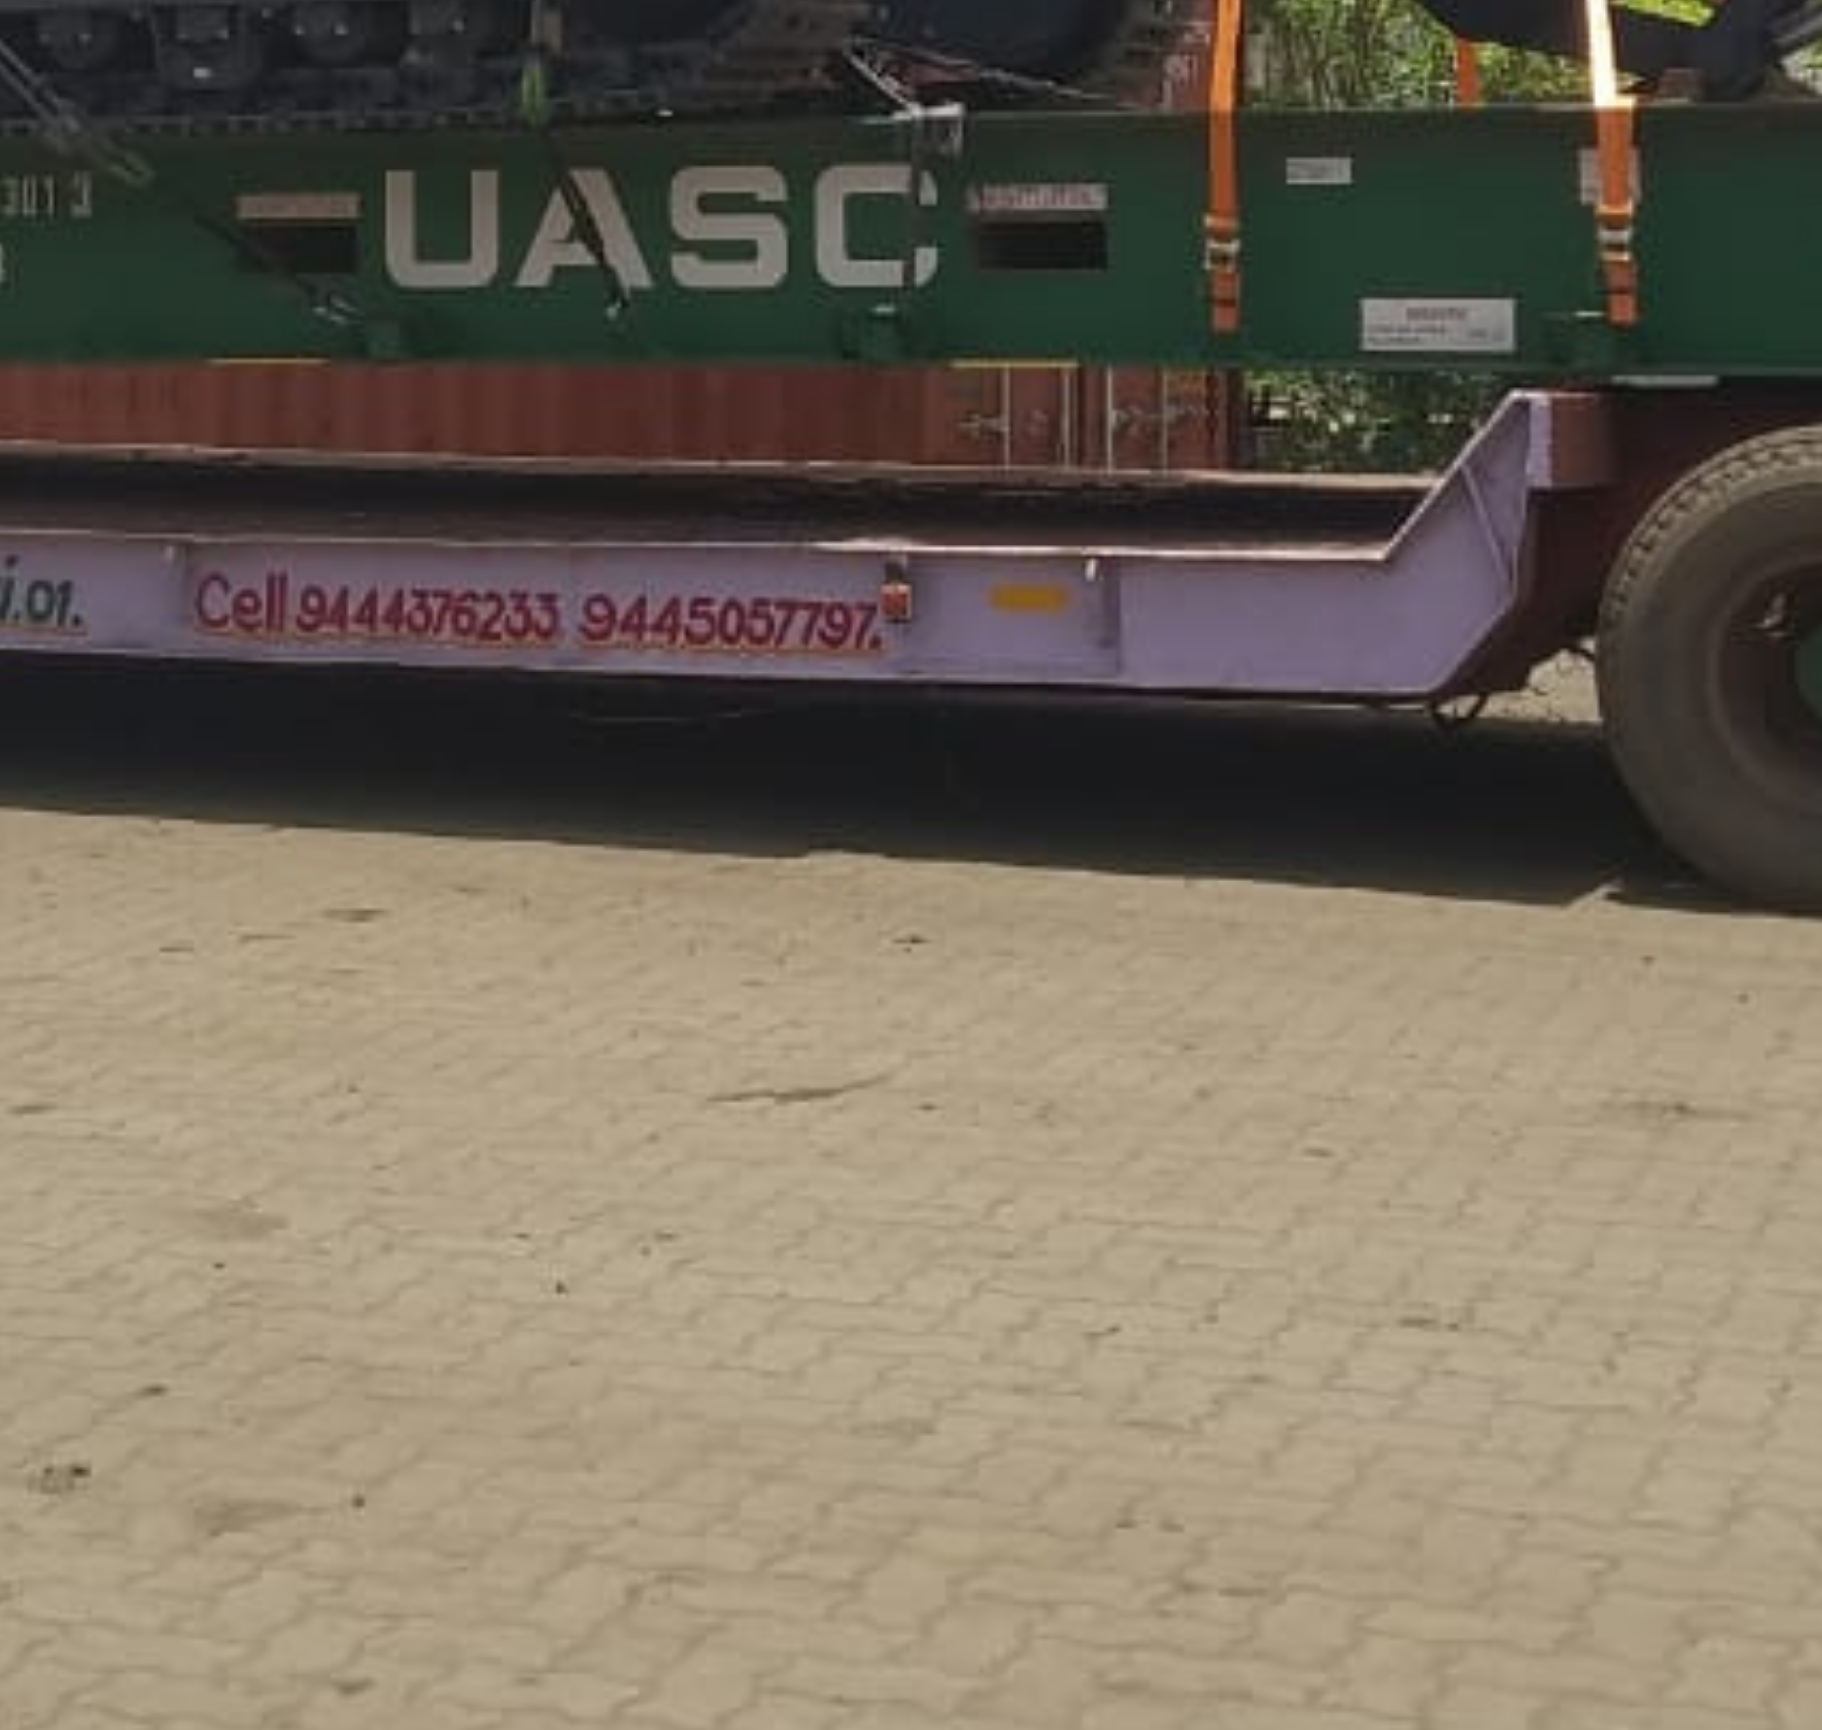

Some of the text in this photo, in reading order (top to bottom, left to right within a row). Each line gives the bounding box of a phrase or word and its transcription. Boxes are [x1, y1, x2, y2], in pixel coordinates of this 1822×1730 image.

[385, 164, 939, 289] UASC
[195, 572, 288, 634] Cell
[295, 584, 560, 642] 9444376233
